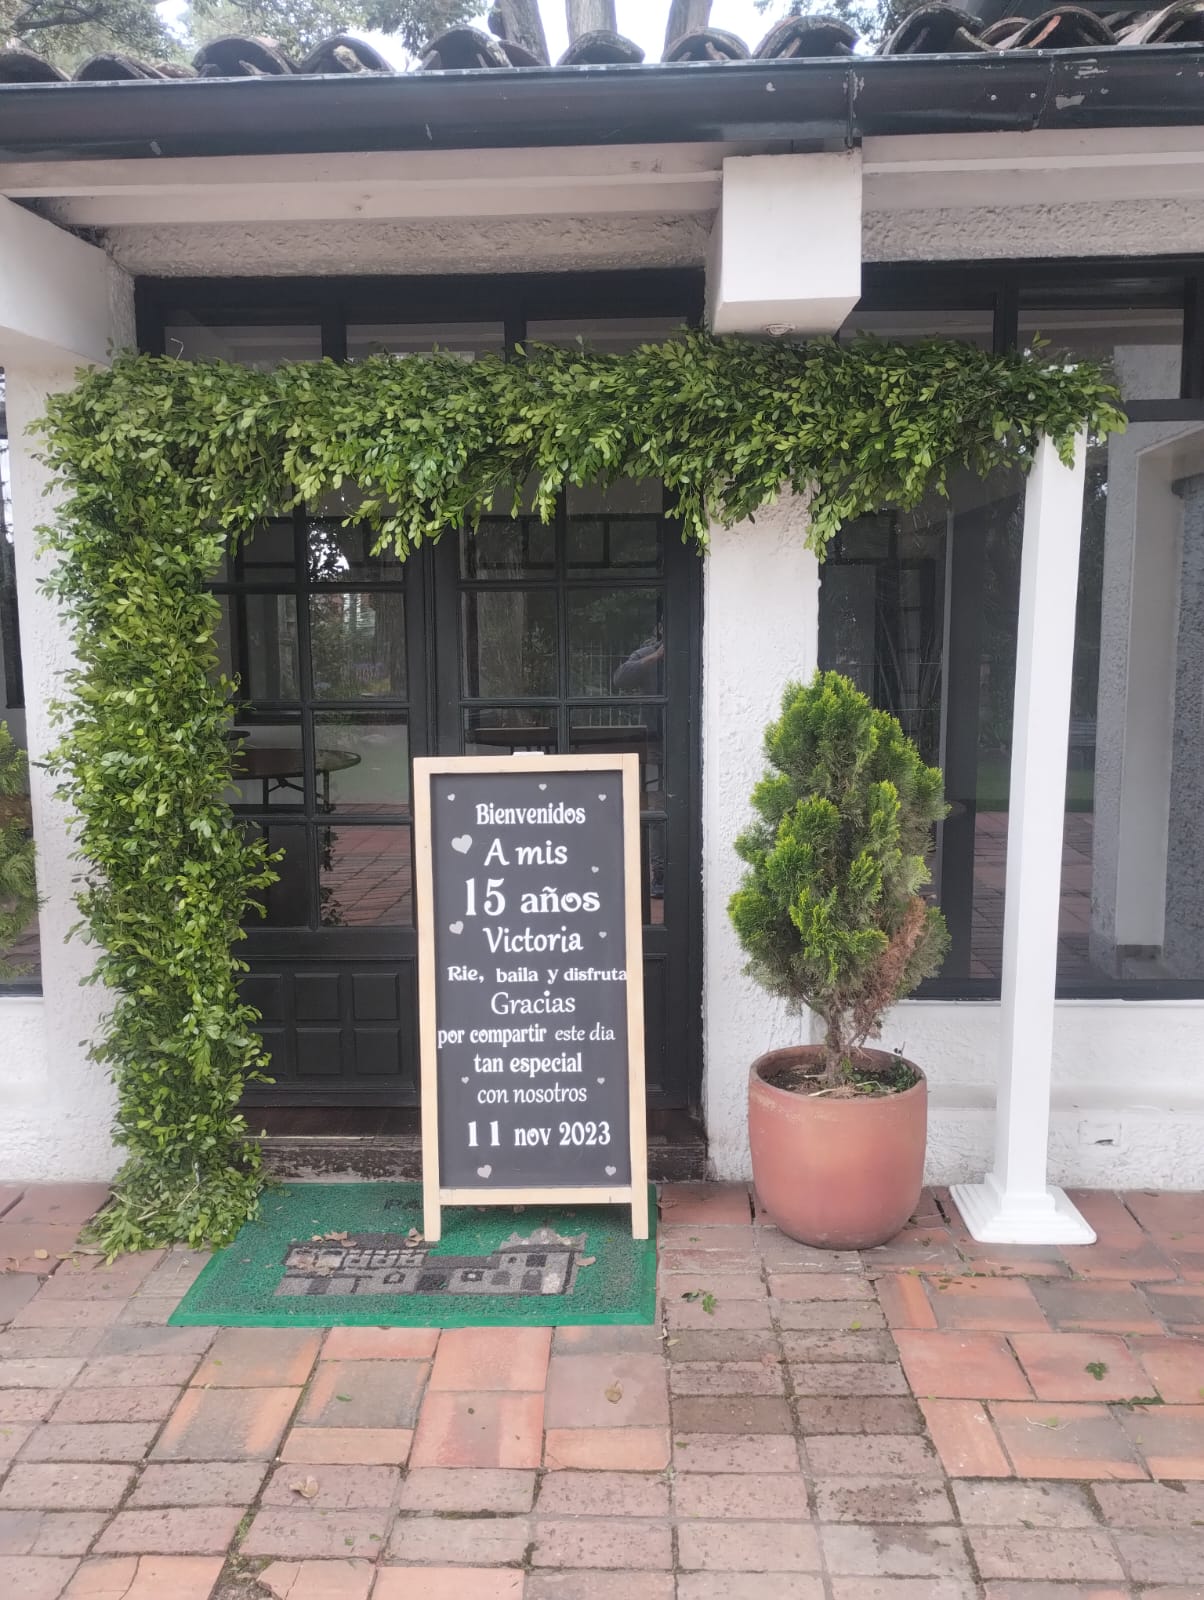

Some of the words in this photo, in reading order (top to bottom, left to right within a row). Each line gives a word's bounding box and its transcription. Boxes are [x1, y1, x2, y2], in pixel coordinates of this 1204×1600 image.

[475, 801, 586, 825] Bienvenidos
[483, 838, 510, 867] A
[514, 839, 568, 866] mis
[464, 876, 506, 917] 15
[520, 886, 601, 914] años
[482, 925, 584, 954] Victoria
[447, 965, 485, 984] Rie,
[495, 967, 539, 983] baila
[546, 968, 559, 985] y
[563, 967, 628, 982] disfruta
[490, 990, 576, 1015] Gracias
[438, 1028, 465, 1049] por
[469, 1022, 547, 1048] compartir
[554, 1024, 586, 1042] este
[588, 1021, 616, 1041] dia
[473, 1052, 504, 1074] tan
[509, 1051, 583, 1079] especial
[476, 1087, 509, 1104] con
[512, 1081, 588, 1104] nosotros
[513, 1126, 552, 1147] nov
[559, 1120, 611, 1147] 2023
